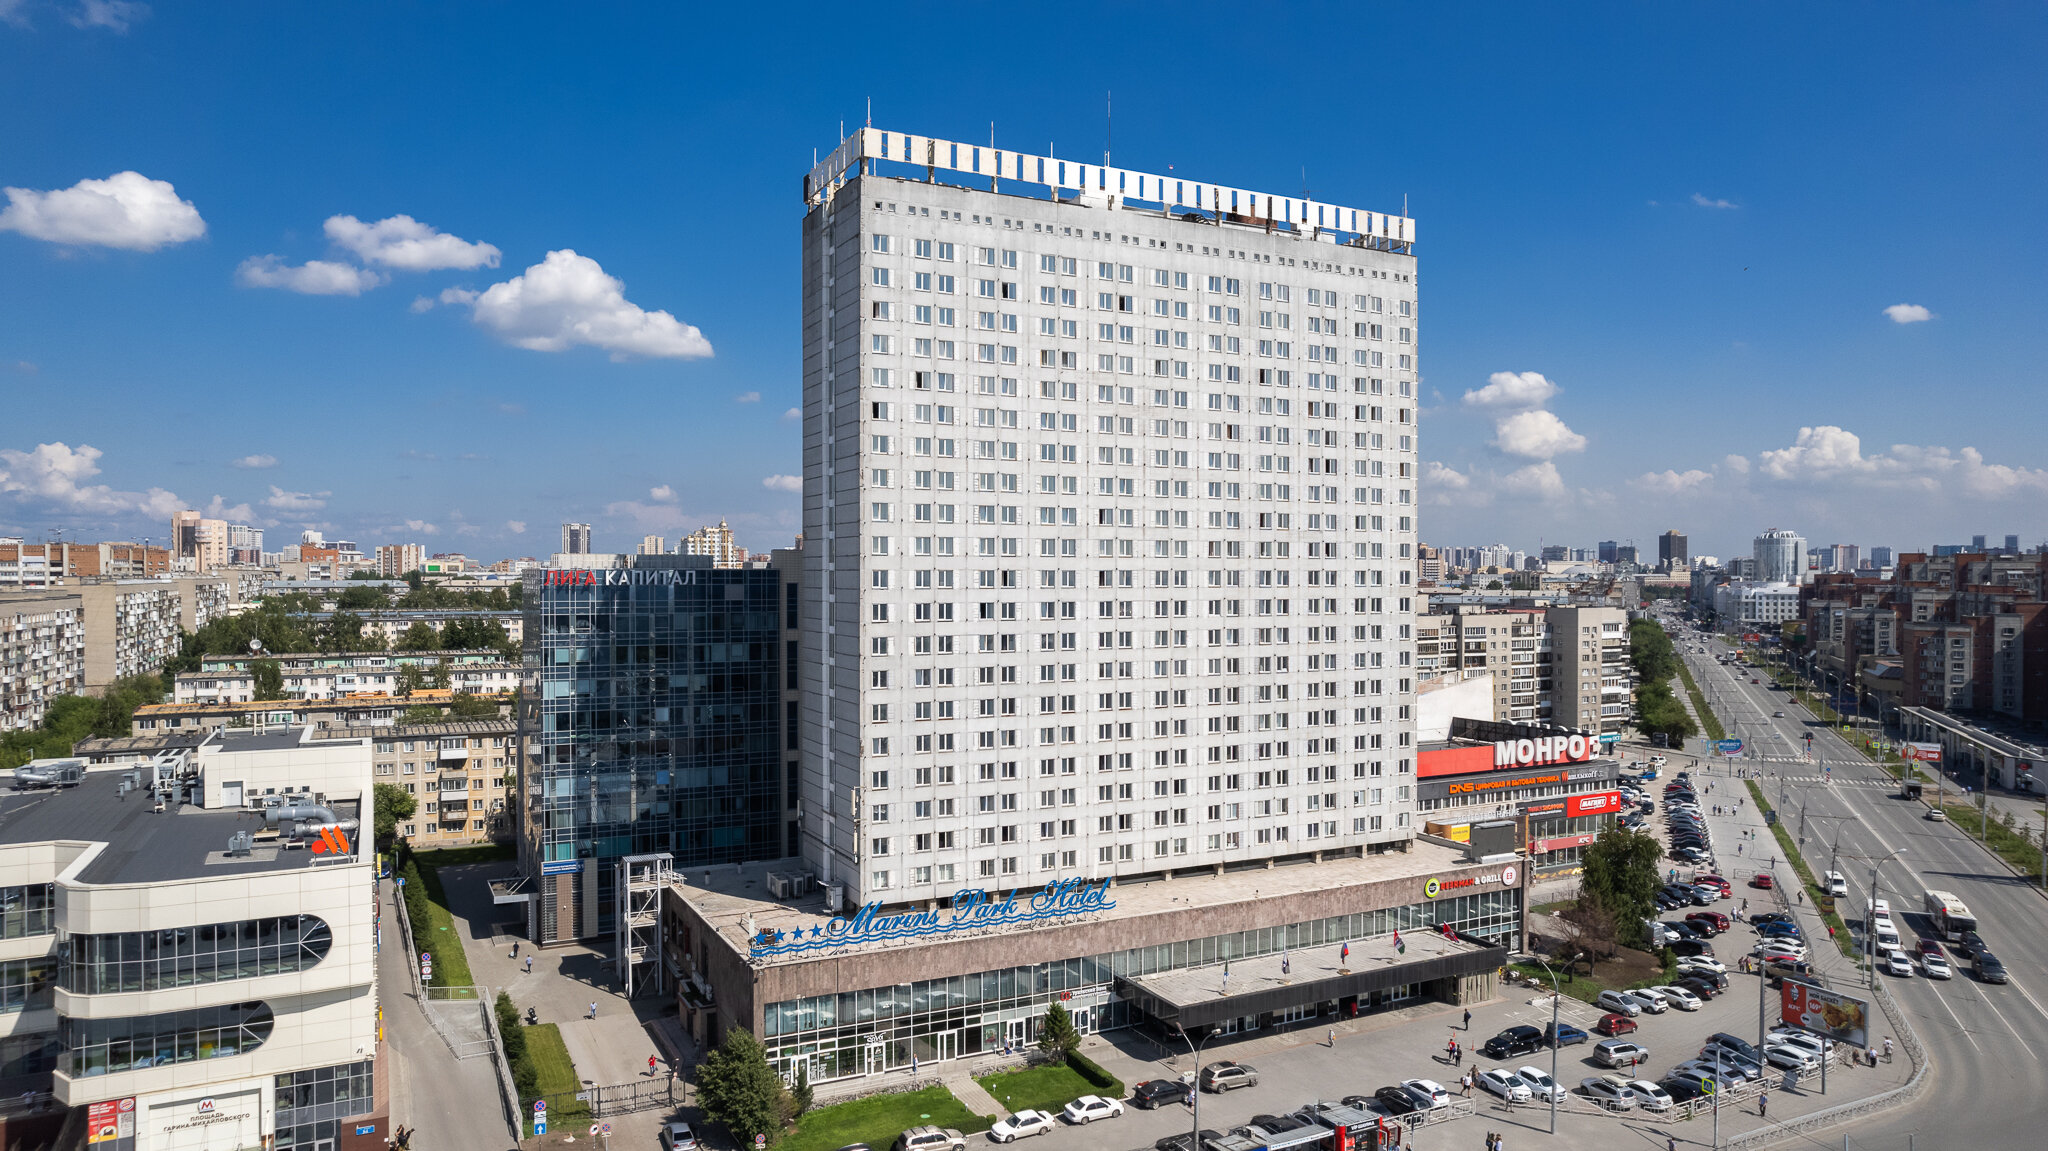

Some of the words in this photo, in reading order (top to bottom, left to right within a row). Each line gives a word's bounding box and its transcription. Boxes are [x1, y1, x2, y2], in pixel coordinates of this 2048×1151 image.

[544, 570, 597, 586] ЛИГА
[605, 570, 697, 586] КАПИТАЛ
[1494, 734, 1586, 766] МОНРО
[1449, 782, 1474, 794] DNS
[1475, 780, 1506, 791] ЦИФРОВАЯ
[1506, 779, 1511, 787] И
[1511, 777, 1536, 787] БЫТОВАЯ
[1536, 775, 1560, 784] ТЕХНИКА
[1581, 798, 1606, 808] МАГНИТ
[1481, 873, 1502, 884] GRILL
[827, 899, 940, 937] Marins
[952, 888, 1018, 922] Park
[1031, 876, 1114, 911] Hotel
[163, 1113, 251, 1132] ГАРИНА-МИХАЙЛОВСКОГО
[190, 1112, 225, 1122] ПЛОЩАДЬ
